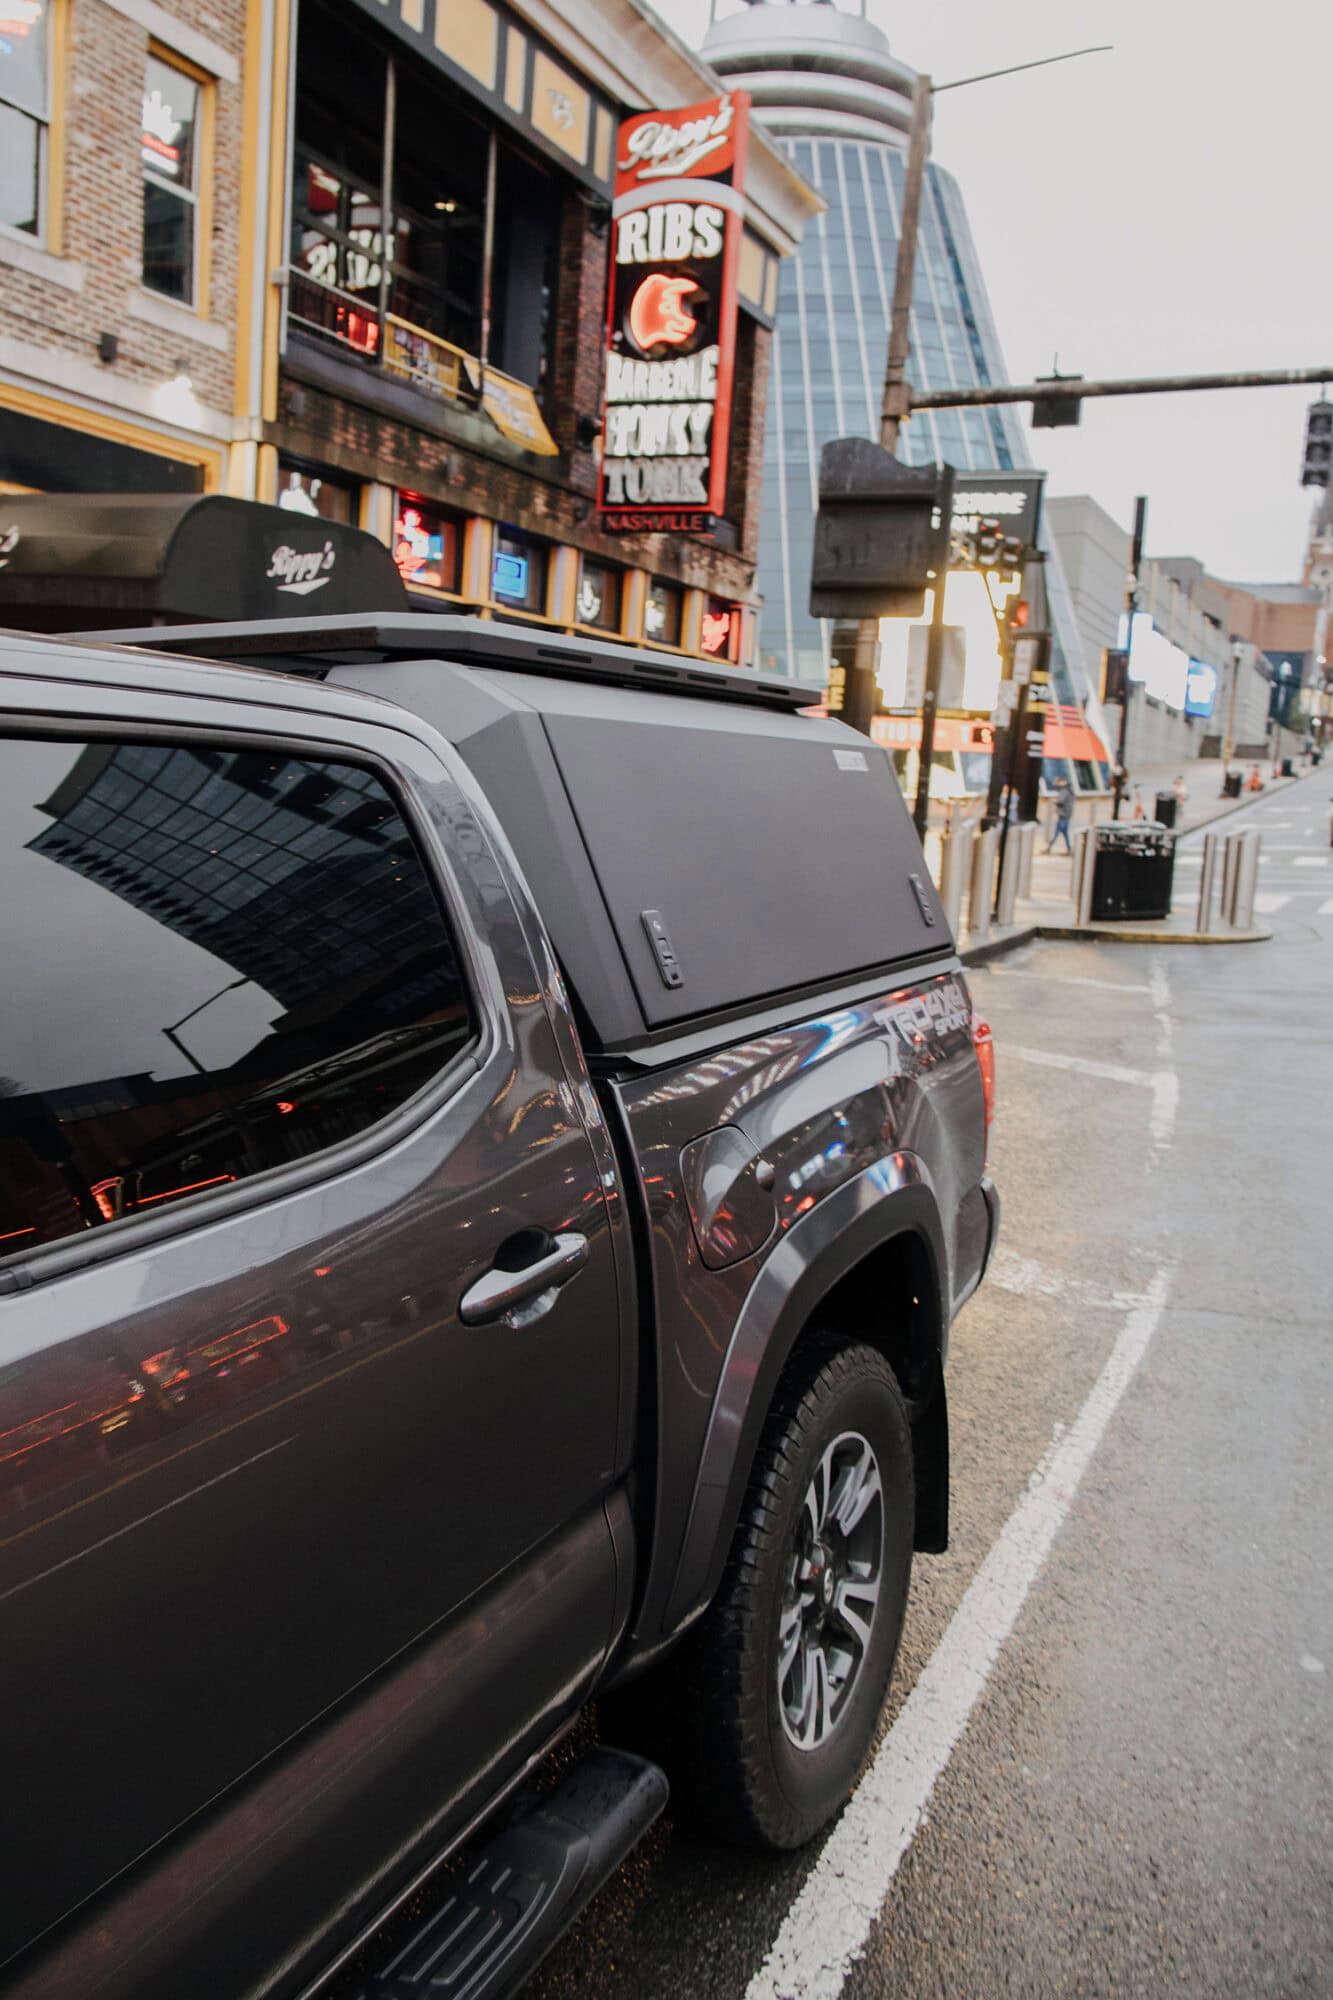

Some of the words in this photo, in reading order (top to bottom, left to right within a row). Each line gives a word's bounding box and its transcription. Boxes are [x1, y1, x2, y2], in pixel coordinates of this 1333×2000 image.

[616, 203, 724, 264] RIBS
[605, 404, 714, 456] HONKY
[603, 456, 710, 504] TONK
[606, 514, 704, 531] NASHVILLE
[266, 541, 335, 583] Rippy's
